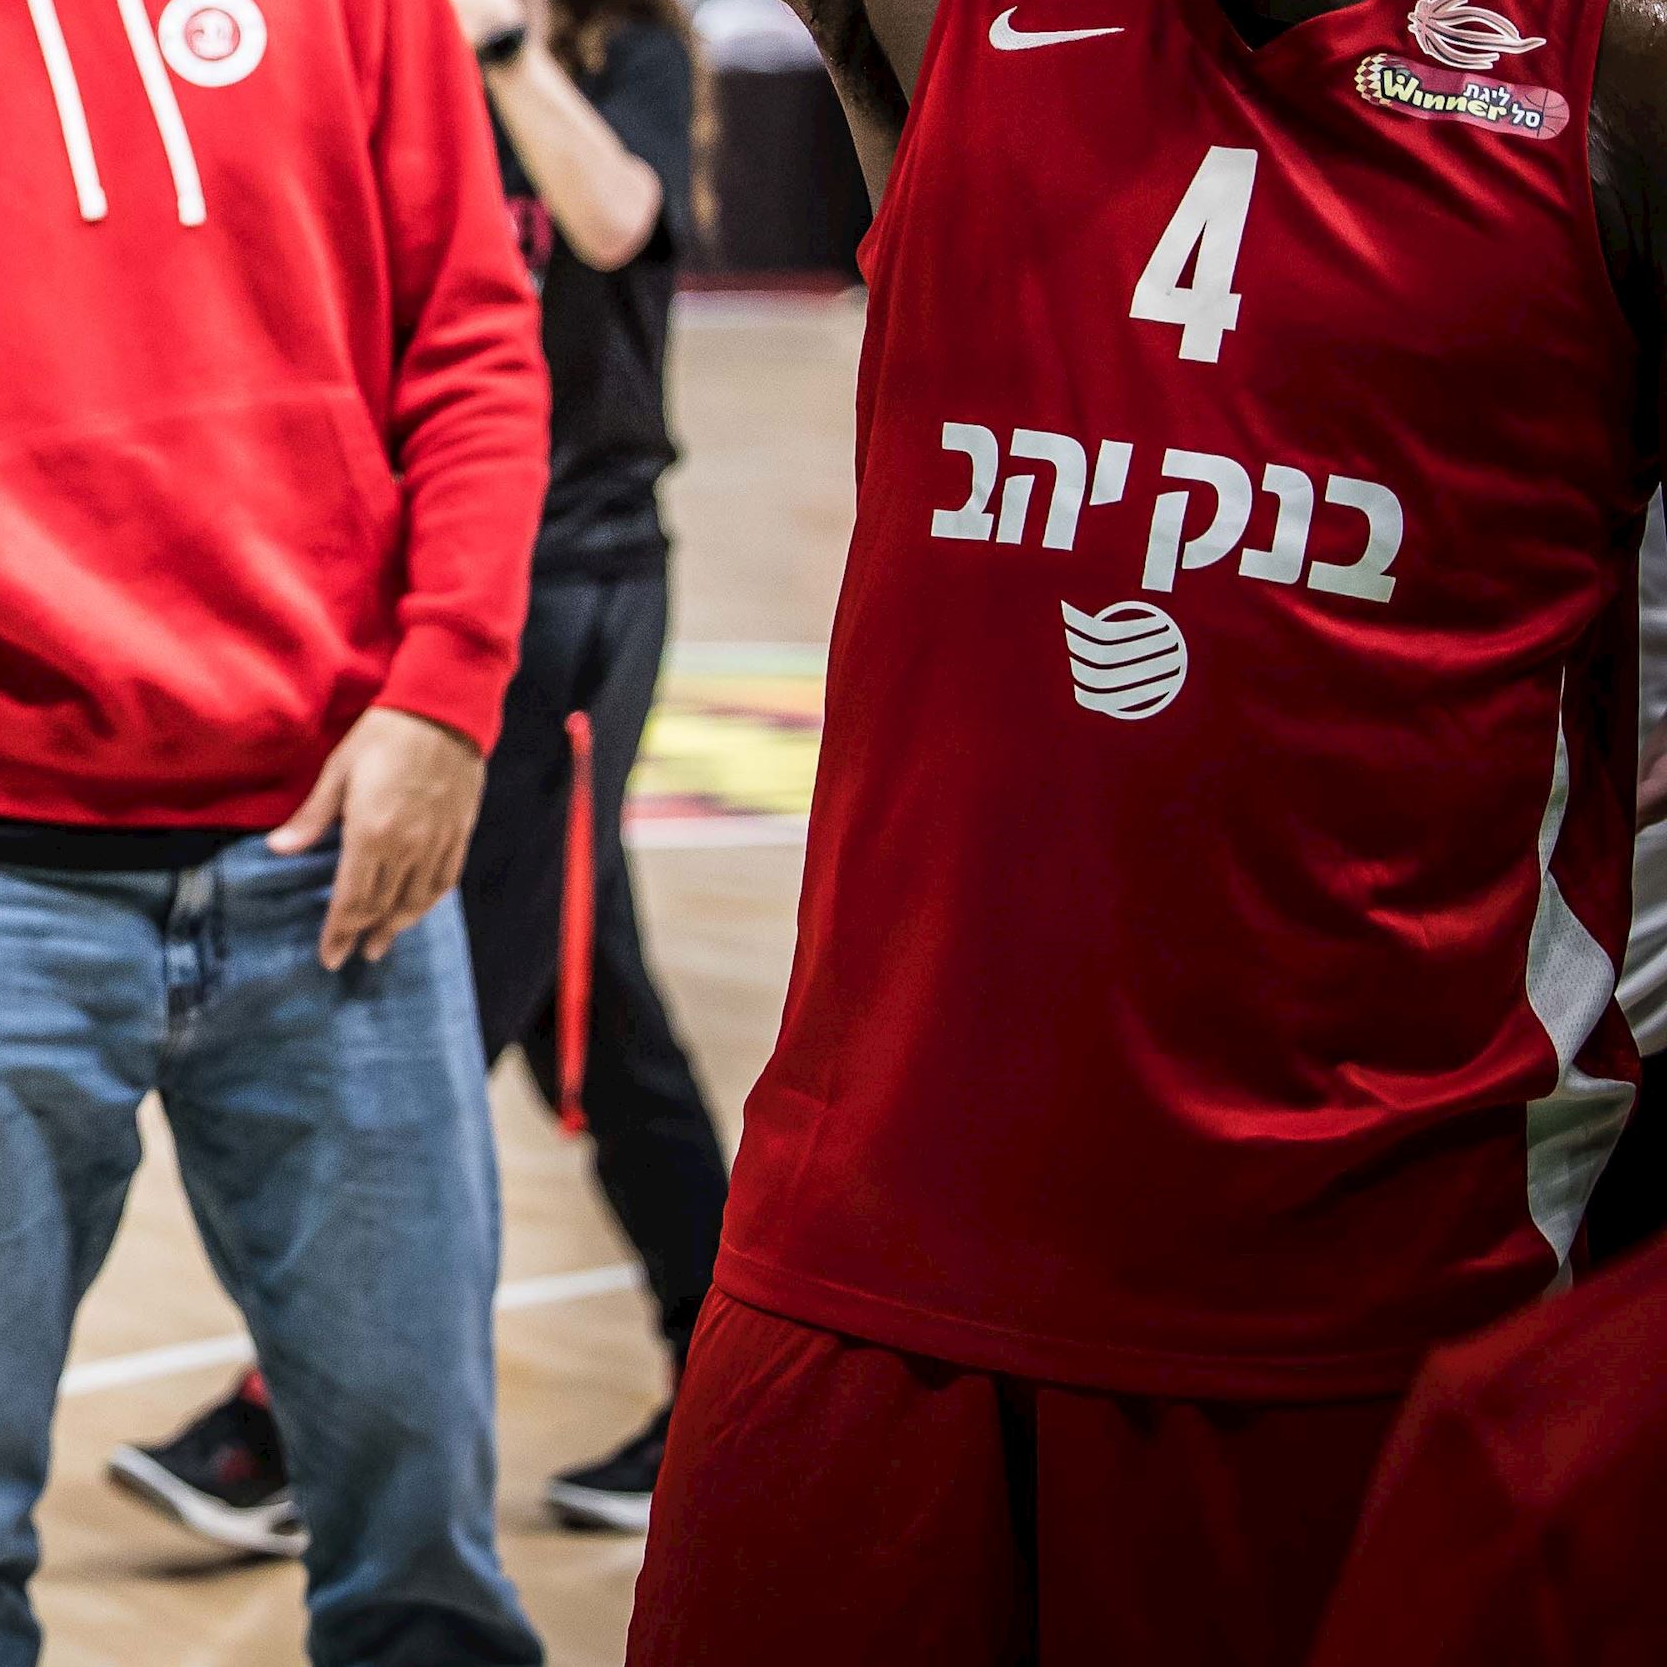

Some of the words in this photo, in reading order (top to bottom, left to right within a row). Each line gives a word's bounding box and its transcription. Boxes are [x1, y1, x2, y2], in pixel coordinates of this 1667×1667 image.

[1382, 68, 1507, 122] Winner
[1464, 83, 1511, 106] ליגת
[1511, 104, 1542, 129] סל
[1129, 145, 1259, 364] 4
[930, 422, 1133, 551] יהב
[1141, 448, 1405, 603] בנק
